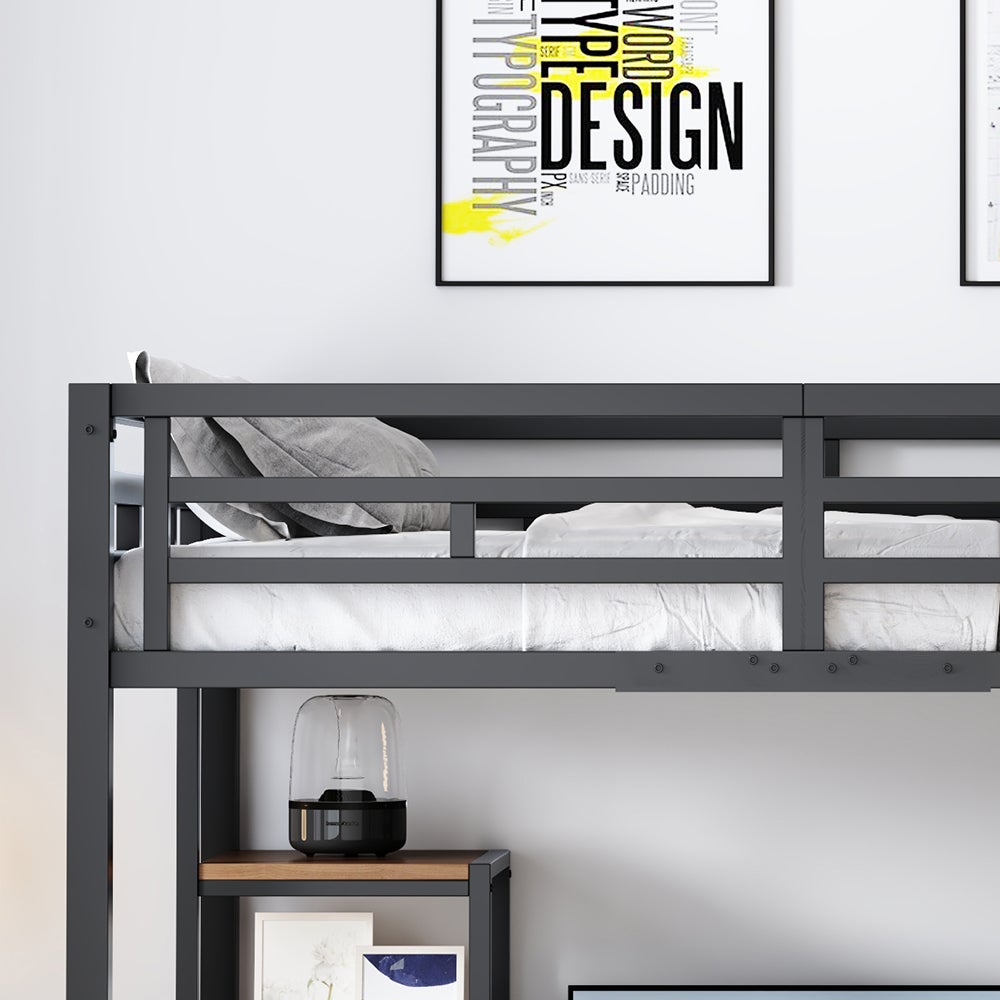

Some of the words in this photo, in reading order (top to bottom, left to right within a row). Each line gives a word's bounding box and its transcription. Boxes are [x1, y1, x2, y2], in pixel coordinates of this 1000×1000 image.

[622, 3, 675, 80] WORD
[472, 13, 538, 216] TYPOGRAPHY
[541, 82, 744, 170] DESIGN
[541, 173, 567, 190] PX
[631, 173, 695, 196] PADDING
